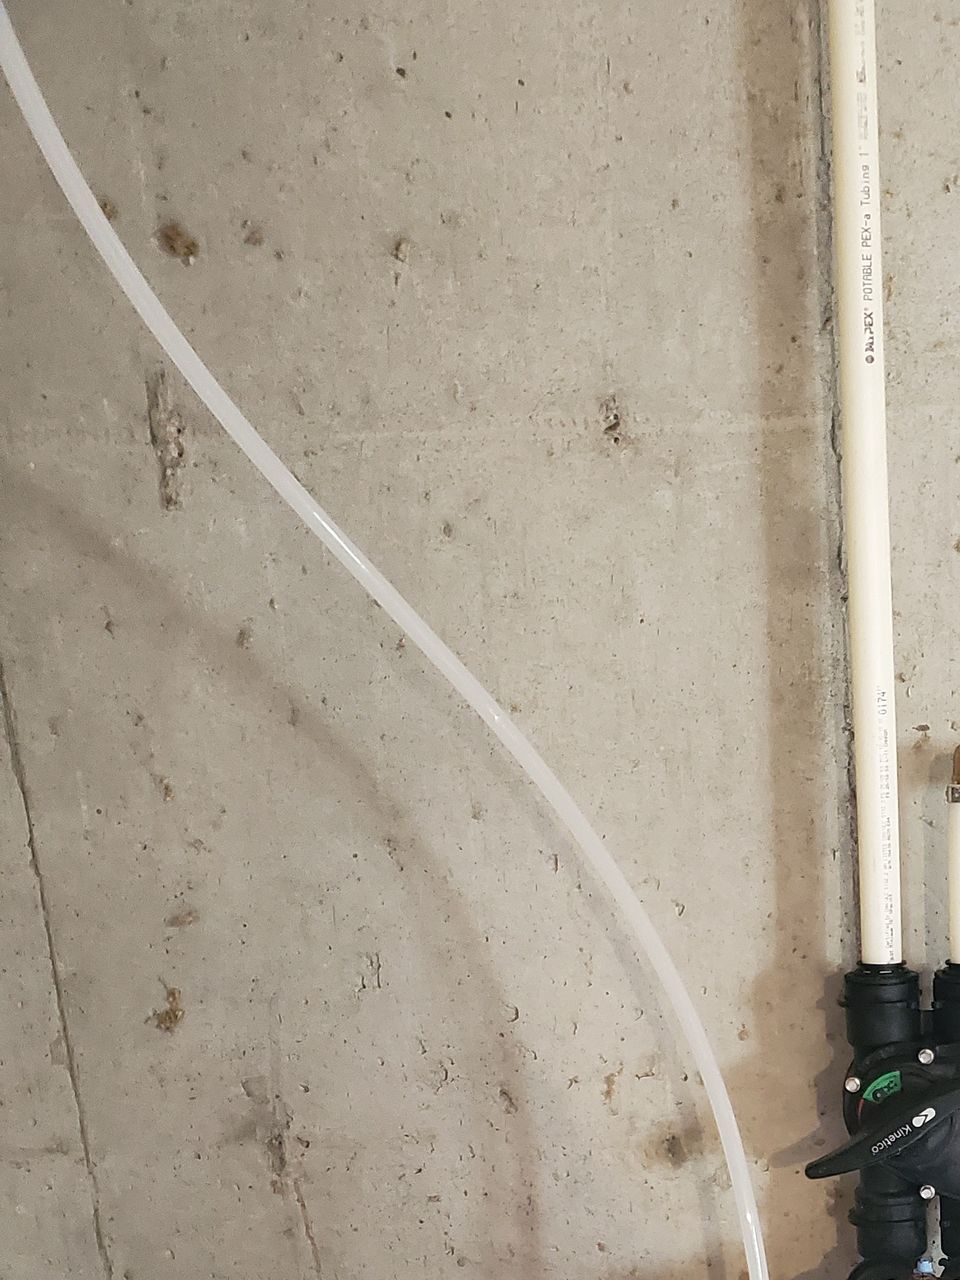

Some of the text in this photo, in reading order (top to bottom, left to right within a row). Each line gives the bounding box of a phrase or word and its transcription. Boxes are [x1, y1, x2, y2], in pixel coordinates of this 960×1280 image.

[859, 164, 871, 206] Tubing
[861, 213, 871, 248] PEX-a
[862, 253, 873, 301] POTABLE
[871, 1124, 912, 1153] Kinetico
